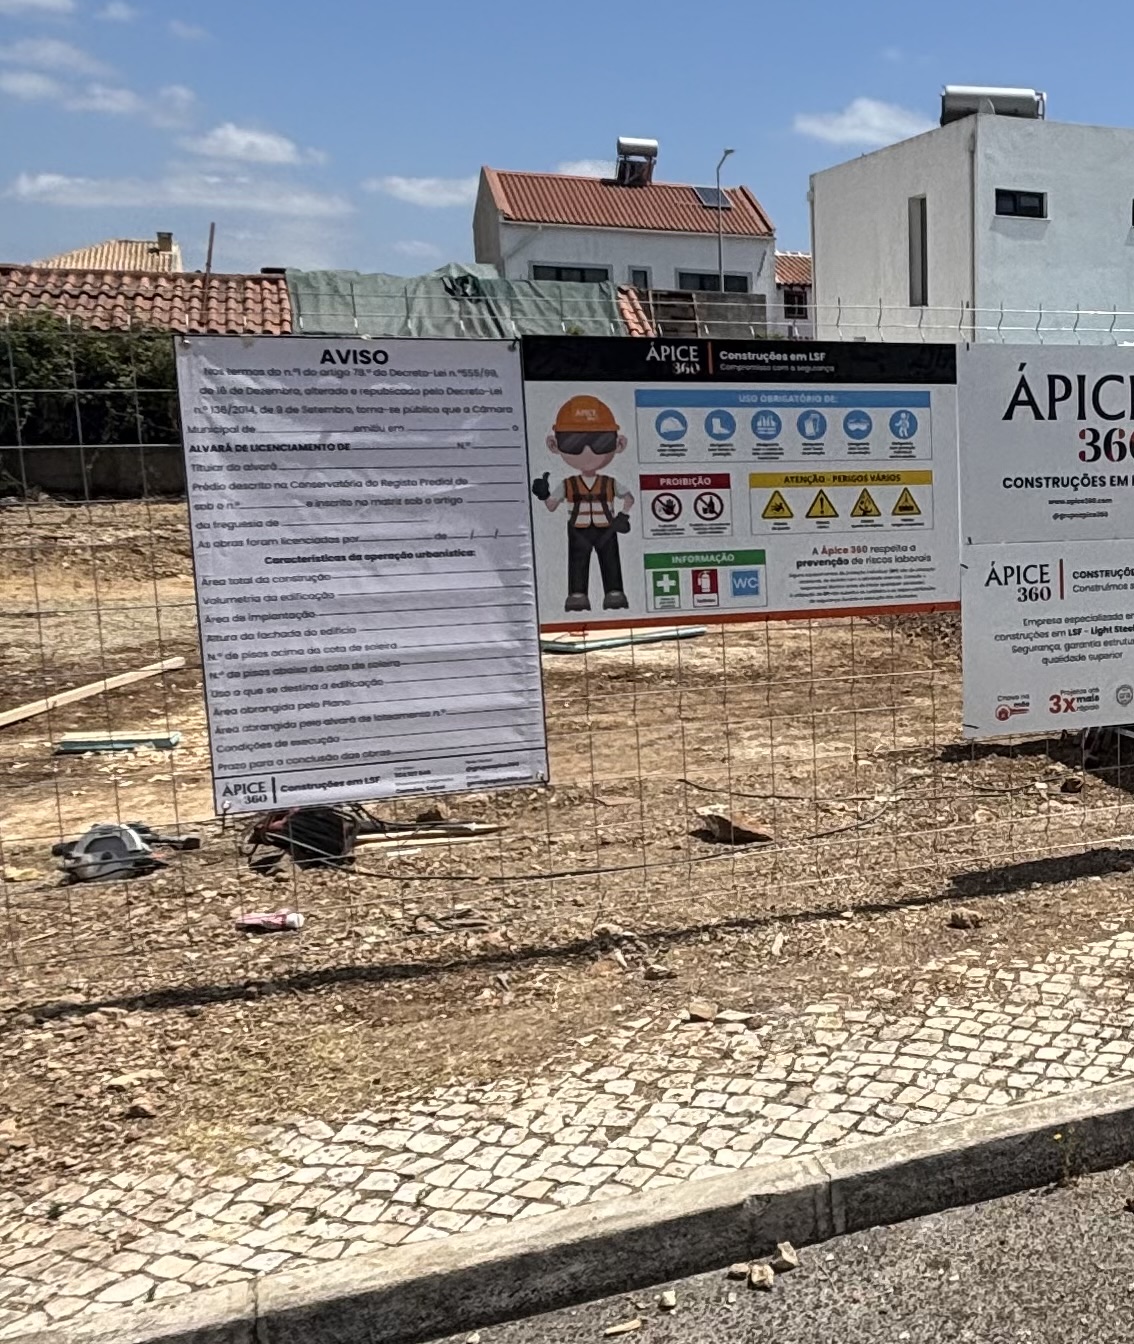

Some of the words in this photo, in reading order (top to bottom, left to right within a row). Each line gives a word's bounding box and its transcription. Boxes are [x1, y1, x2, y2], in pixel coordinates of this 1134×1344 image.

[320, 349, 389, 365] AVISO
[645, 341, 700, 362] ÁPICE
[719, 351, 788, 364] Construções
[789, 353, 807, 362] em
[808, 352, 827, 362] LSF
[225, 367, 265, 377] termos
[266, 367, 282, 377] do
[302, 367, 317, 377] do
[319, 368, 351, 379] artigo
[373, 369, 387, 377] do
[389, 368, 447, 378] Decreto-Lei
[672, 362, 701, 376] 360
[796, 365, 835, 374] segurança
[199, 387, 214, 396] de
[229, 387, 244, 396] de
[245, 387, 303, 397] Dezembro,
[304, 387, 349, 396] alterado
[350, 388, 357, 396] e
[359, 386, 421, 398] republicado
[422, 386, 445, 397] pelo
[446, 387, 503, 396] Decreto-Lei
[739, 395, 759, 403] USO
[760, 393, 822, 404] OBRIGATÓRIO
[260, 405, 273, 414] de
[284, 405, 299, 414] de
[302, 405, 355, 416] Setembro,
[356, 406, 400, 414] torna-se
[402, 405, 440, 416] público
[441, 406, 461, 416] que
[463, 406, 470, 414] a
[472, 405, 513, 414] Câmara
[189, 443, 233, 453] ALVARÁ
[234, 443, 248, 453] DE
[250, 443, 335, 453] LICENCIAMENTO
[337, 442, 351, 452] DE
[226, 464, 241, 472] do
[243, 462, 278, 472] alvará
[659, 476, 712, 487] PROIBIÇÃO
[784, 474, 826, 485] ATENÇÃO
[832, 474, 869, 484] PERIGOS
[870, 472, 901, 483] VÁRIOS
[1002, 473, 1107, 492] CONSTRUÇÕES
[1109, 475, 1129, 487] EM
[811, 547, 820, 556] A
[821, 544, 849, 557] Ápice
[870, 544, 908, 556] respeita
[264, 552, 347, 565] Características
[348, 553, 363, 562] da
[364, 551, 414, 563] operação
[671, 553, 735, 565] INFORMAÇÃO
[796, 555, 850, 569] prevenção
[851, 556, 864, 565] de
[865, 555, 893, 565] riscos
[894, 554, 932, 564] laborais
[228, 576, 253, 586] total
[255, 575, 270, 584] da
[272, 573, 332, 584] construção
[984, 560, 1051, 587] ÁPICE
[732, 577, 759, 589] WC
[1016, 586, 1052, 603] 360
[1022, 617, 1063, 628] Empresa
[1064, 612, 1124, 625] especializada
[994, 630, 1050, 642] construções
[1051, 629, 1066, 638] em
[1067, 628, 1083, 637] LSF
[1090, 625, 1113, 638] Light
[1064, 639, 1101, 652] garantia
[1041, 653, 1087, 666] qualidade
[1088, 651, 1124, 664] superior
[1049, 694, 1077, 715] 3x
[1076, 694, 1100, 704] mais
[216, 741, 273, 754] Condições
[274, 739, 288, 749] de
[290, 736, 340, 747] execução
[218, 761, 247, 771] Prazo
[249, 759, 274, 770] para
[286, 753, 339, 766] conclusão
[340, 750, 361, 760] das
[362, 749, 391, 758] obras
[222, 779, 267, 797] ÁPICE
[280, 779, 345, 793] Construções
[346, 777, 363, 787] em
[364, 775, 381, 785] LSF
[243, 794, 268, 805] 360
